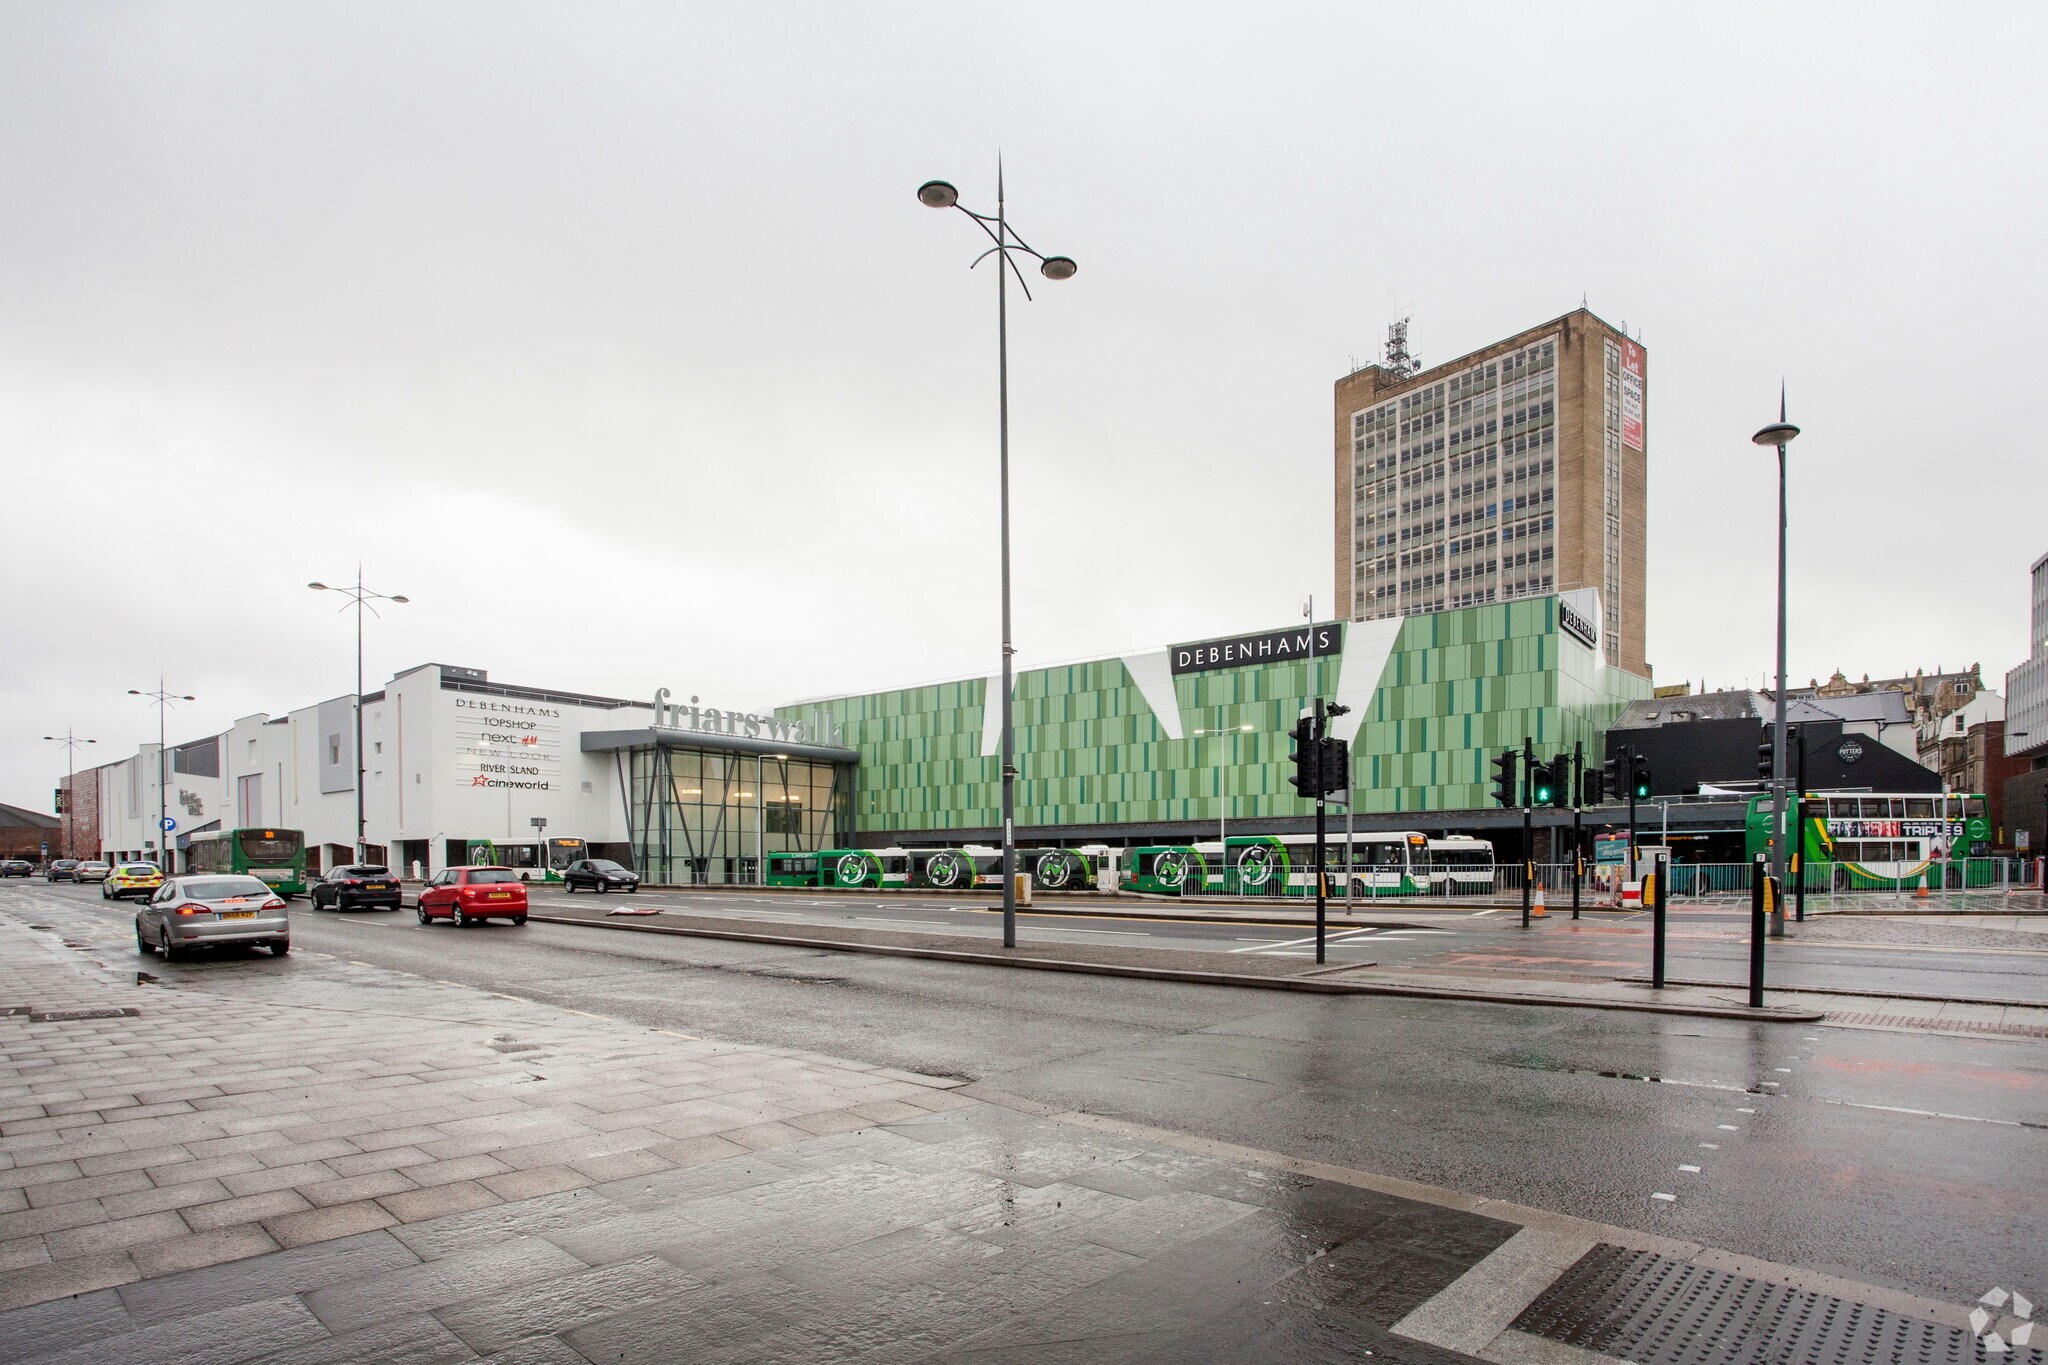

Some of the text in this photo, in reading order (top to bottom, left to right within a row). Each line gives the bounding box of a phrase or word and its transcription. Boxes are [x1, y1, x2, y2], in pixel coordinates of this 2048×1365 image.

[1627, 342, 1636, 358] To
[1626, 356, 1639, 374] Let
[1623, 371, 1642, 390] OFFICE
[1623, 386, 1641, 403] SPACE
[1179, 631, 1330, 667] DEBENHAMS
[455, 698, 560, 718] DEBENHAMS
[483, 717, 536, 730] TOPSHOP
[654, 687, 847, 749] friars walk
[481, 732, 517, 744] next
[466, 747, 551, 761] NEW LOOK
[480, 763, 539, 776] RIVER SLAND
[487, 779, 549, 790] cineworld
